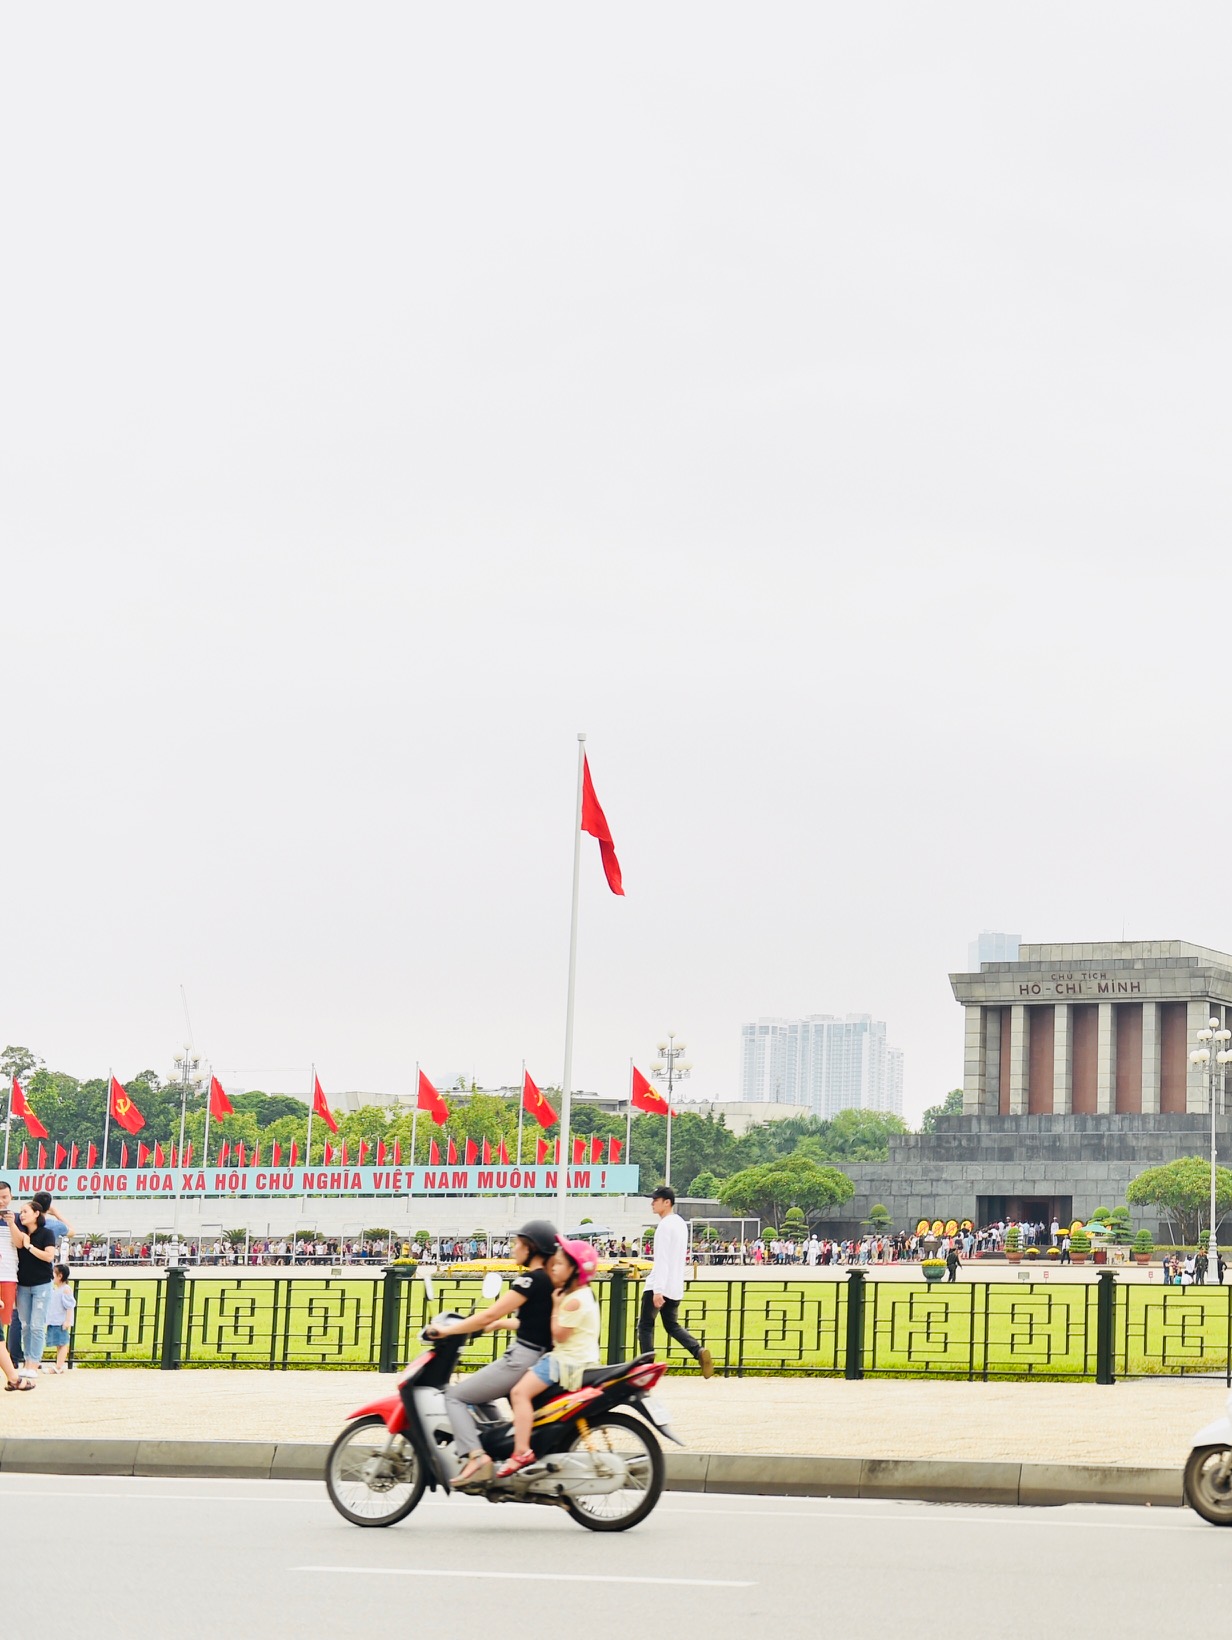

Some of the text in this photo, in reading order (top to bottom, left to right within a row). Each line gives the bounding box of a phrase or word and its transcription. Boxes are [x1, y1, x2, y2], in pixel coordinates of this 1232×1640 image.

[18, 1170, 69, 1191] NƯỚC
[77, 1171, 128, 1195] CỘNG
[136, 1170, 174, 1191] HÒA
[181, 1170, 207, 1191] XÃ
[214, 1170, 248, 1194] HỘI
[255, 1168, 294, 1190] CHỦ
[302, 1169, 363, 1190] NGHĨA
[372, 1167, 415, 1192] VIỆT
[423, 1171, 469, 1189] NAM
[477, 1167, 537, 1189] MUÔN
